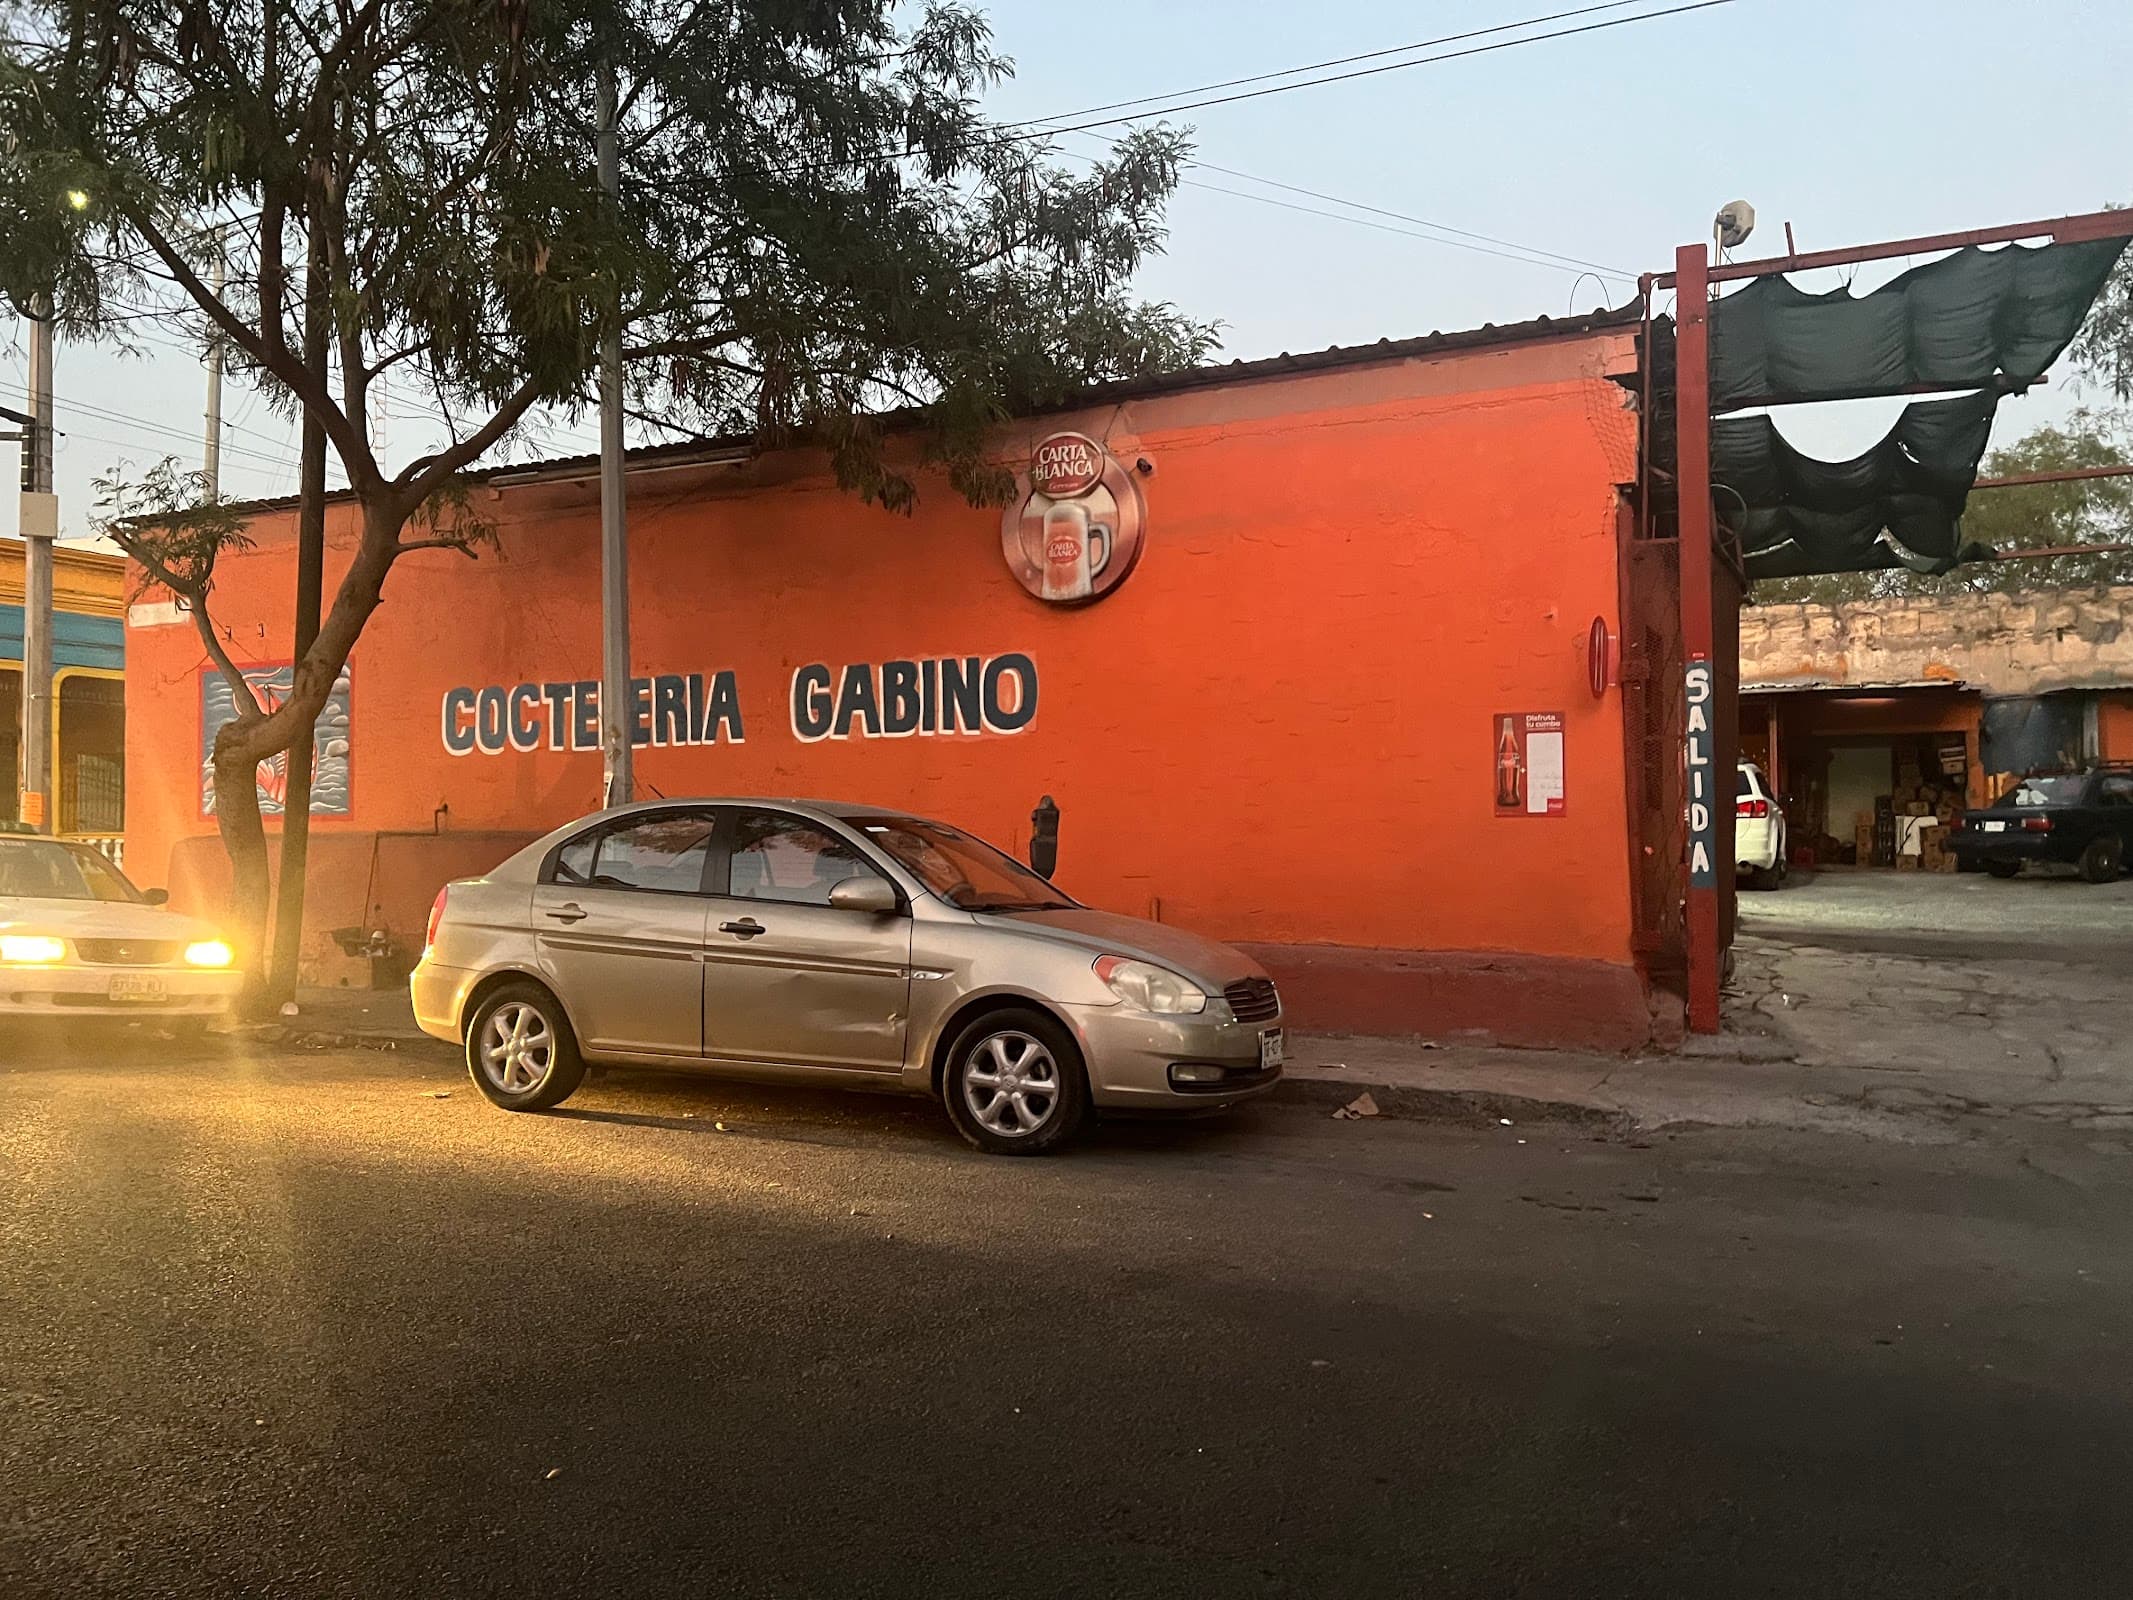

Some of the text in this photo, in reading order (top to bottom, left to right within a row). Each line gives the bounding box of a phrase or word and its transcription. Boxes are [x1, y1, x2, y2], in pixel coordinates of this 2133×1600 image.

[1035, 460, 1094, 480] BLANCA
[1040, 444, 1087, 465] CARTA
[441, 652, 1038, 757] COCTEERIA GABINO
[1685, 668, 1711, 873] SALIDA
